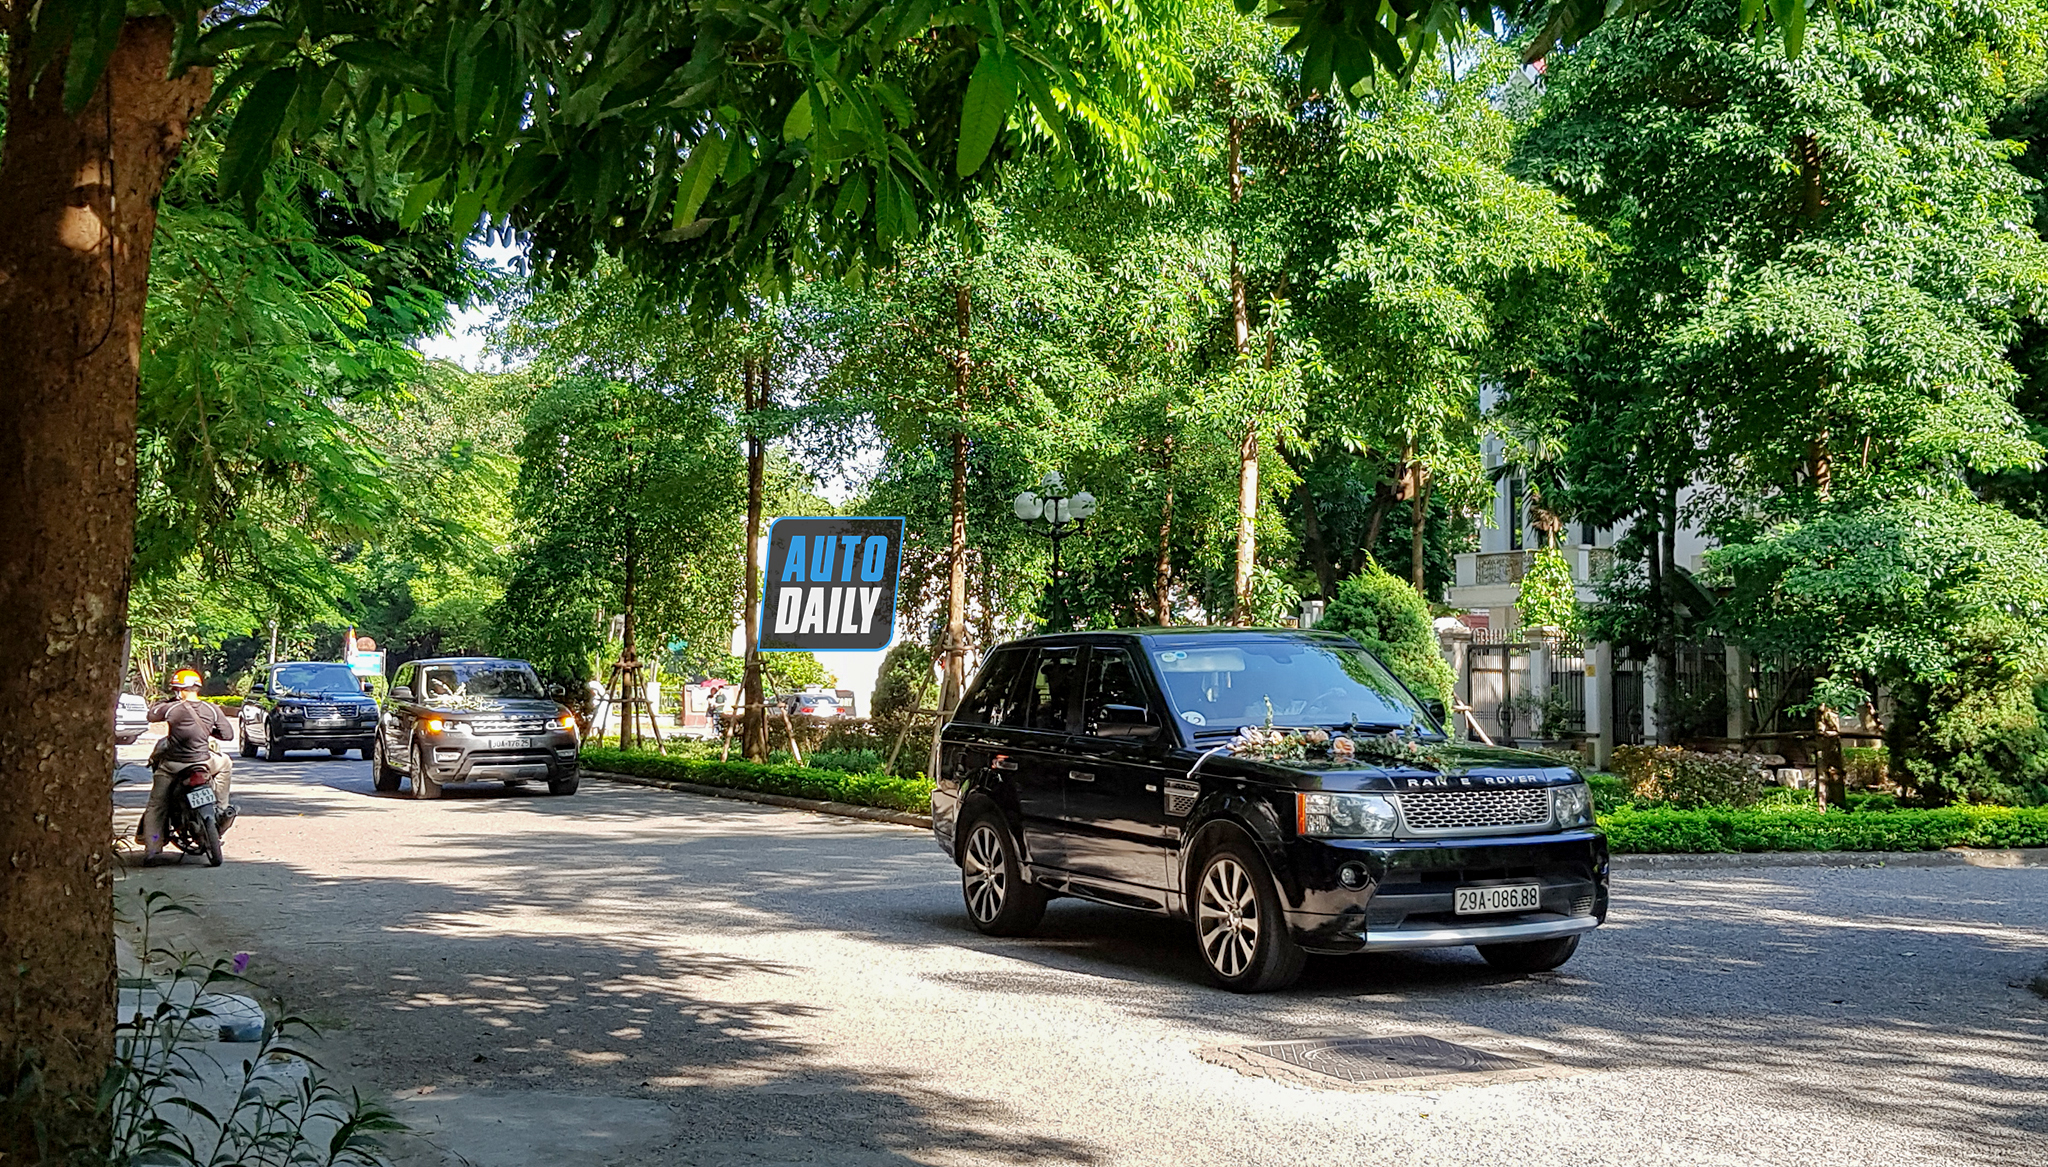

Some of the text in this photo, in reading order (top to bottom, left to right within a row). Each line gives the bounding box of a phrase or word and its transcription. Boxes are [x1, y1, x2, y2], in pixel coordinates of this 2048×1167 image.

[1407, 775, 1537, 787] RANE ROVER
[1459, 887, 1537, 911] 29A-086.88
